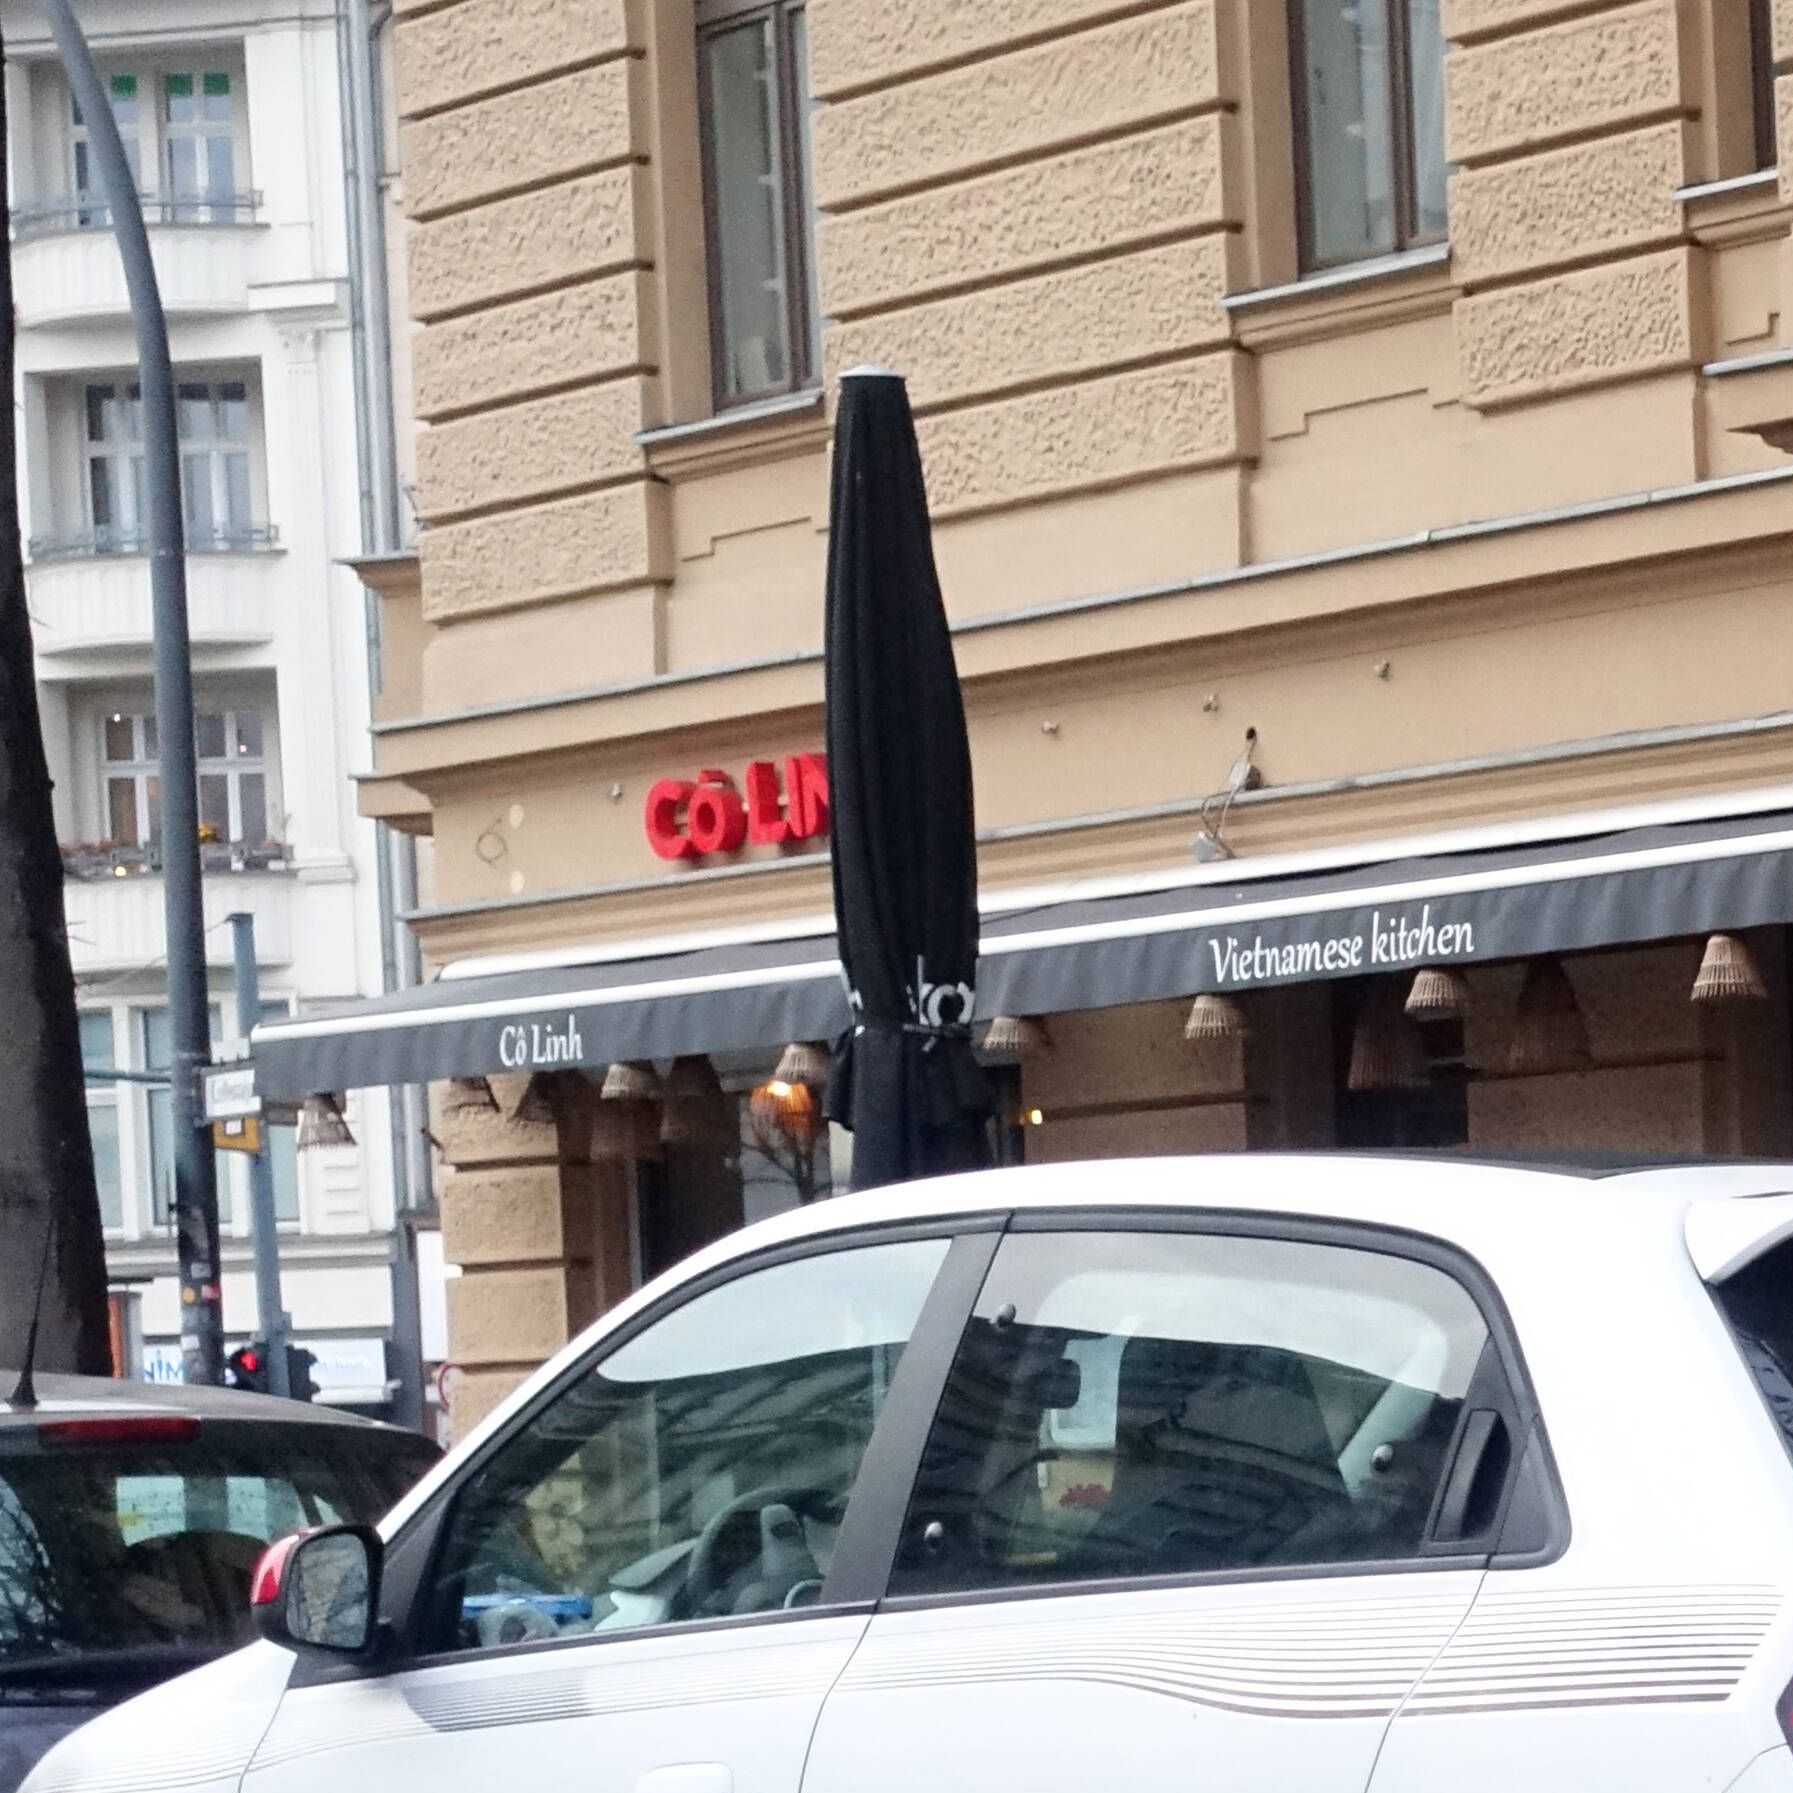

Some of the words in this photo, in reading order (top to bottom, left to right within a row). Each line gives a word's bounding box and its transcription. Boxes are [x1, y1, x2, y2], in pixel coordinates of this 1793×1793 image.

[746, 752, 830, 846] LIN
[1208, 935, 1363, 983] Vietnamese
[1371, 904, 1475, 964] kitchen
[500, 1025, 527, 1067] Cô
[531, 1013, 583, 1064] Linh
